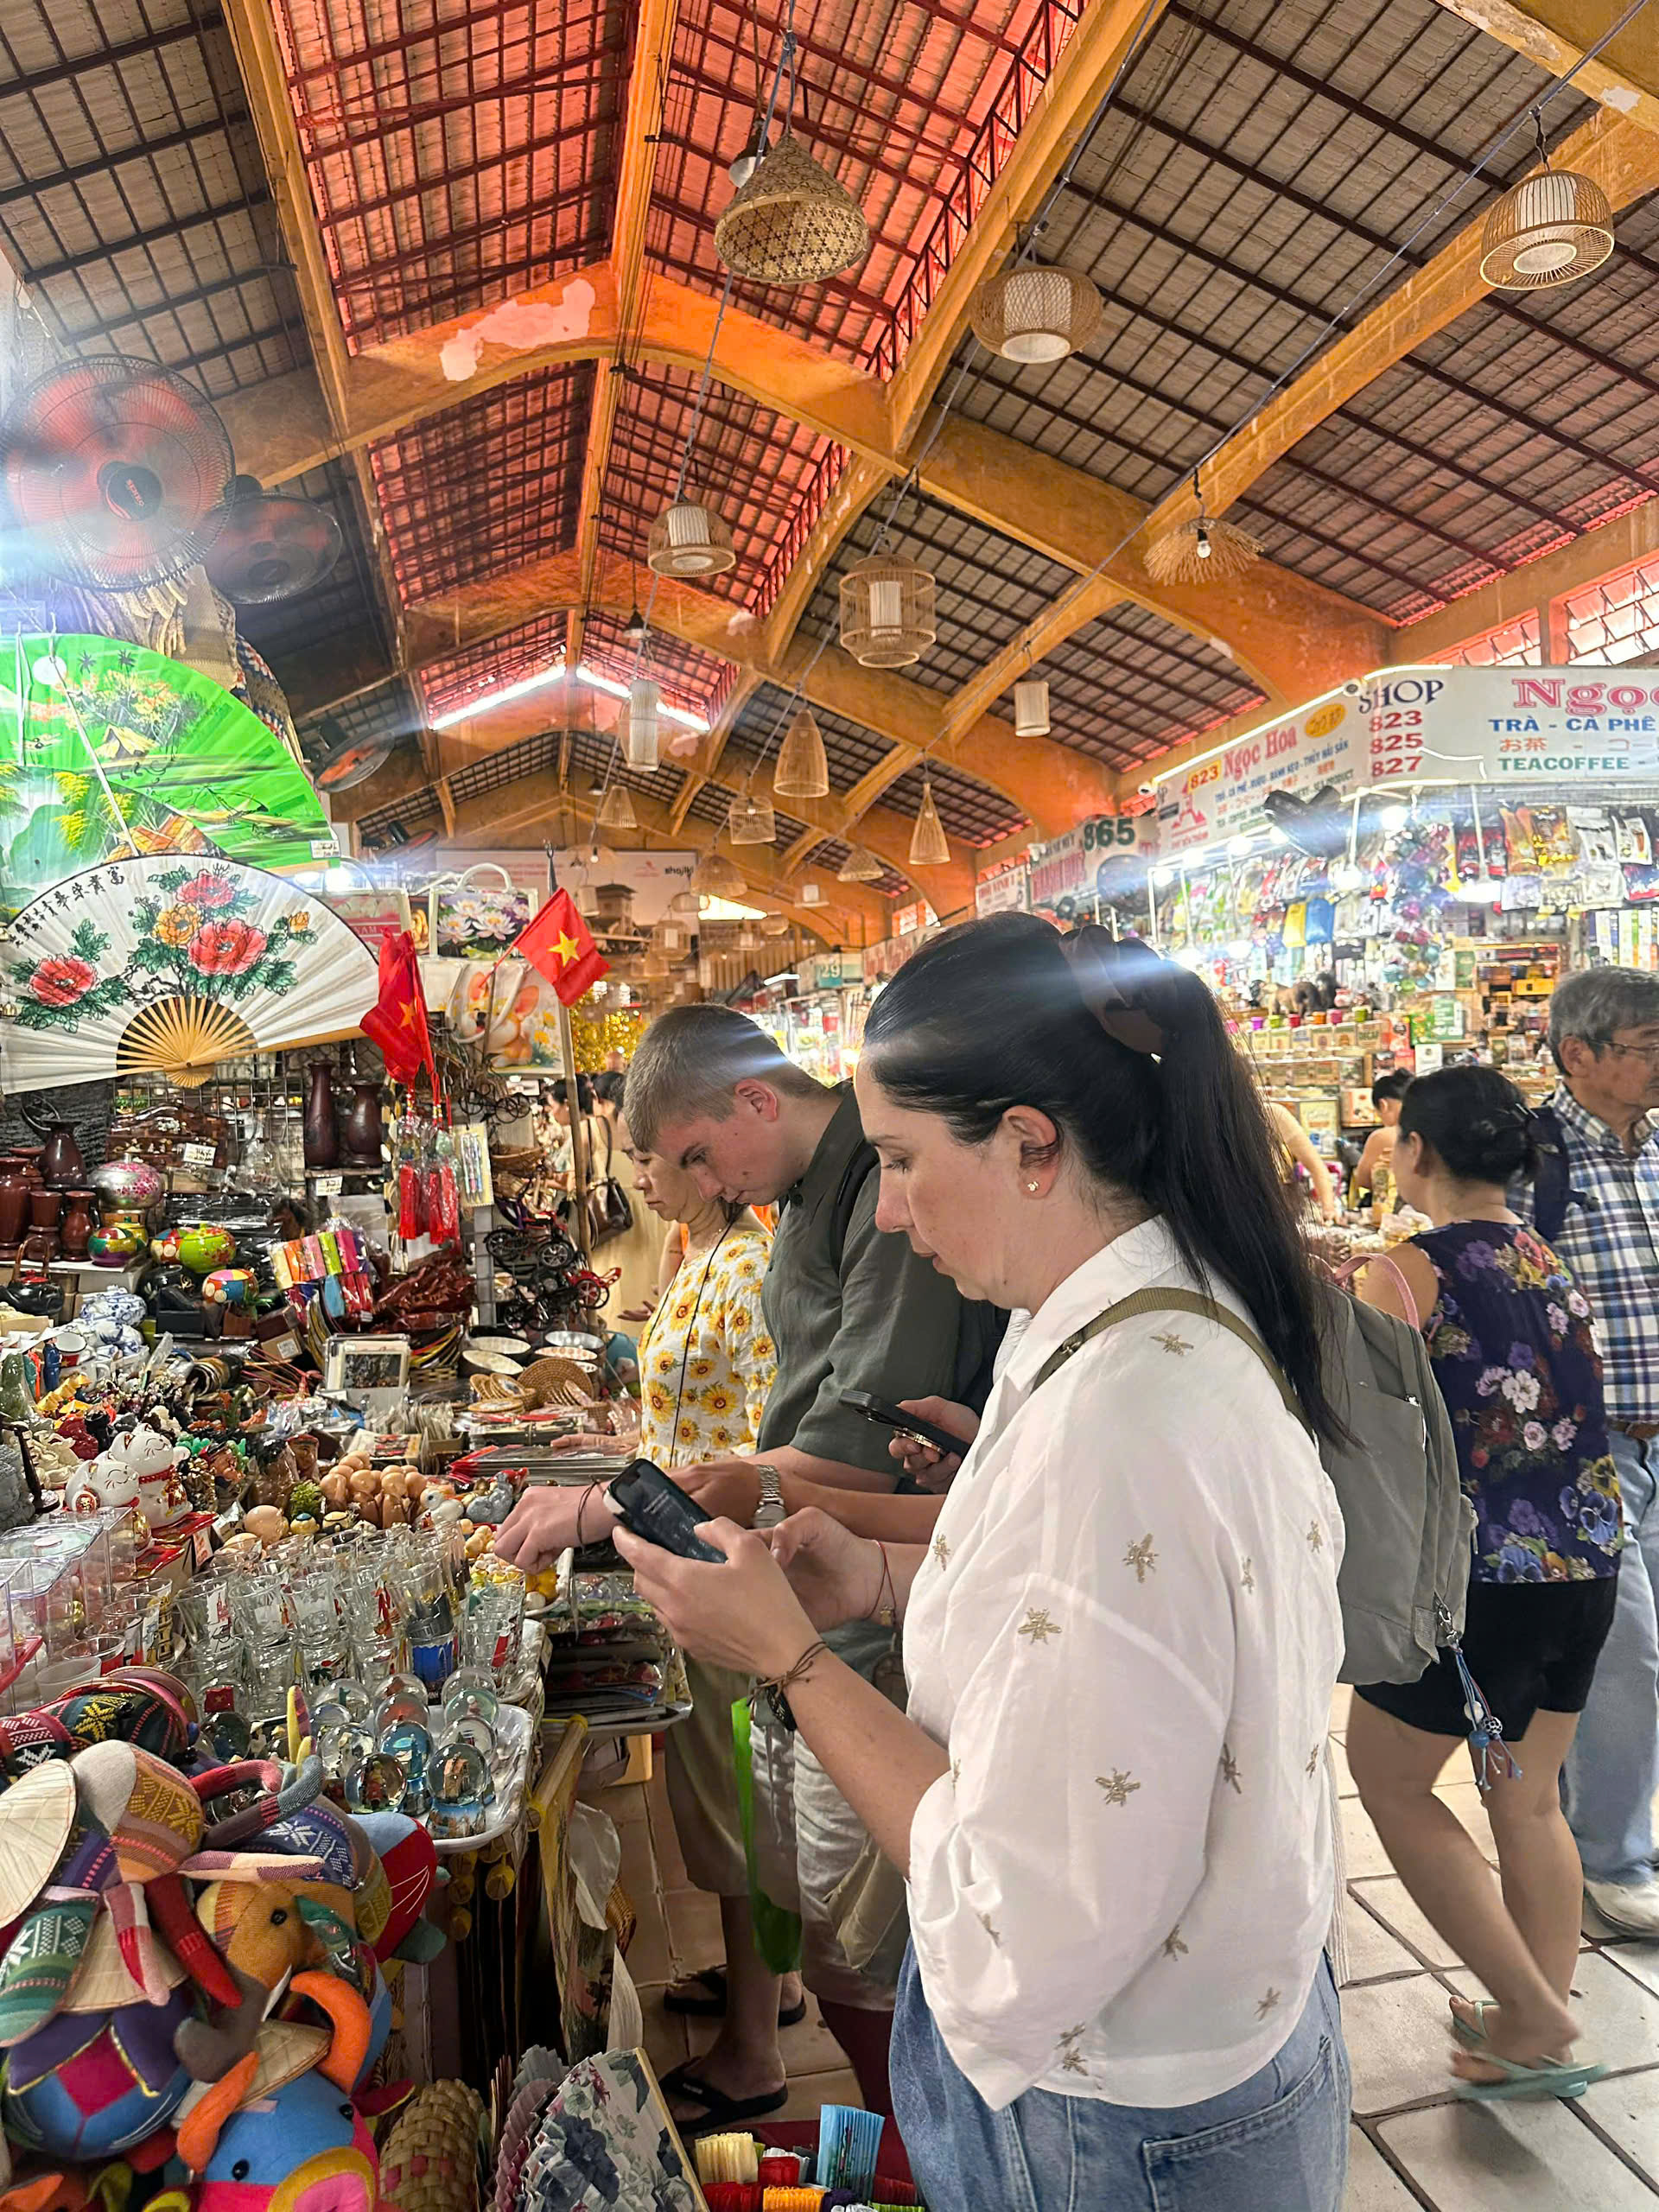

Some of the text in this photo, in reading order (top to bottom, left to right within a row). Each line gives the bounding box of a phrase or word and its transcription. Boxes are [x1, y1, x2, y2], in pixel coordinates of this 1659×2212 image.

[1359, 679, 1444, 715] SHOP
[1369, 710, 1423, 733] 823
[1489, 715, 1540, 732] TRÀ
[1566, 715, 1599, 732] CÀ
[1608, 715, 1656, 732] PHÊ
[1224, 725, 1299, 781] Ngọc Hoa
[1370, 733, 1424, 754] 825
[1499, 737, 1548, 753] お茶
[1371, 755, 1423, 778] 827
[1498, 757, 1630, 772] TEACOFFEE
[1191, 765, 1218, 790] 823
[1084, 817, 1135, 852] 865
[821, 963, 841, 979] 29
